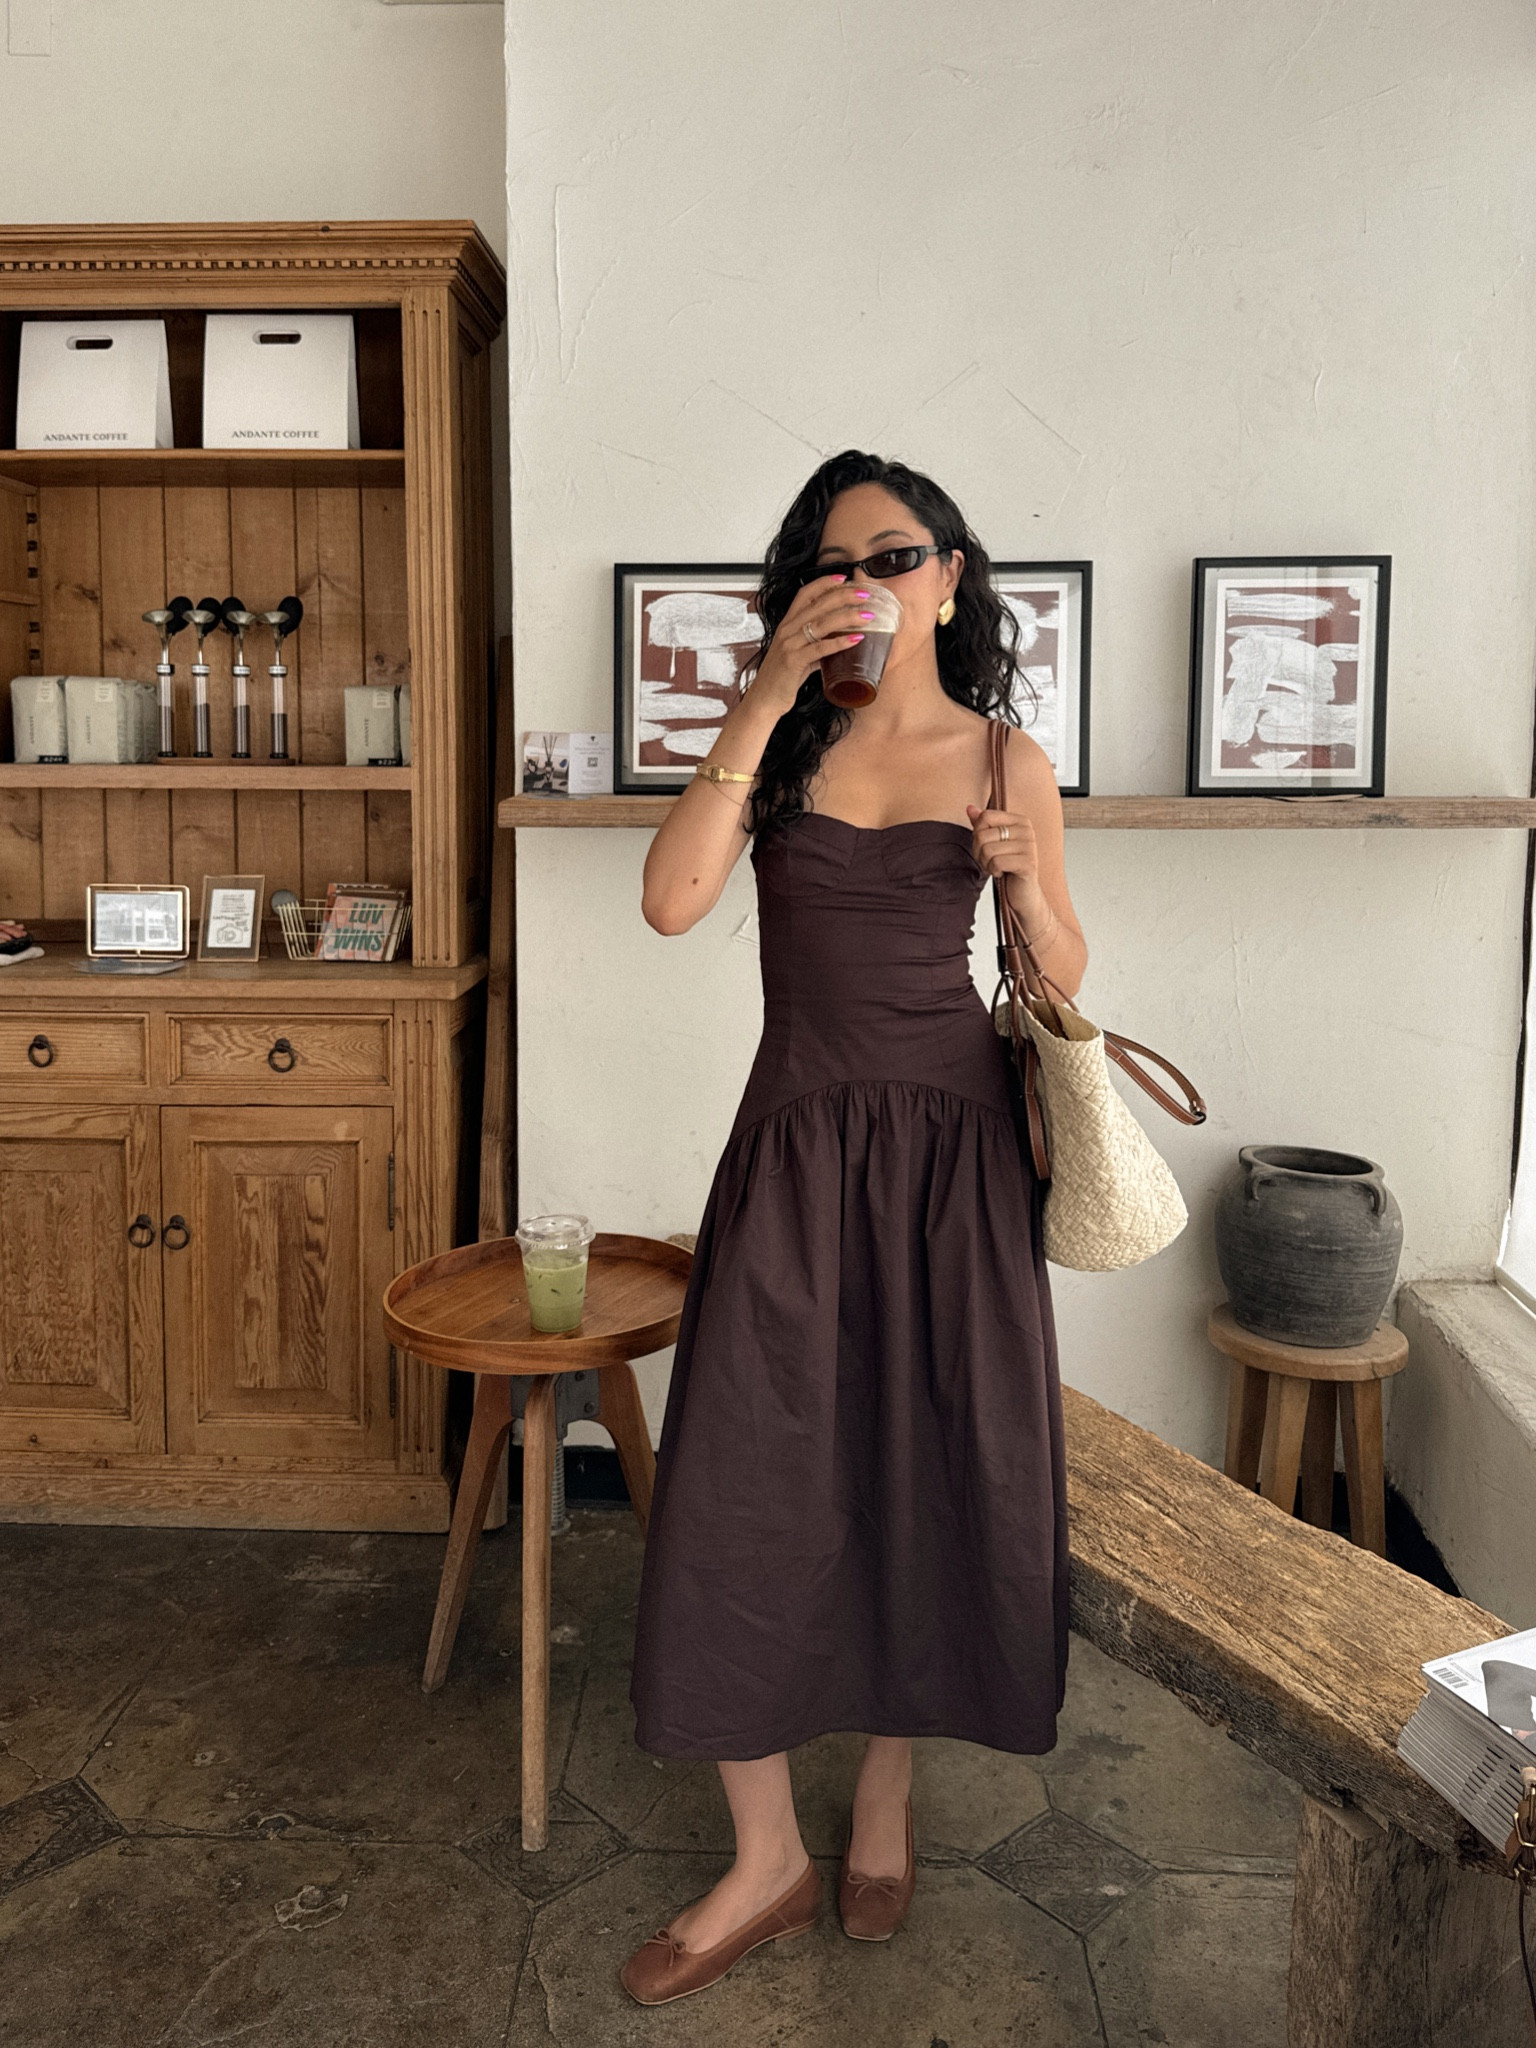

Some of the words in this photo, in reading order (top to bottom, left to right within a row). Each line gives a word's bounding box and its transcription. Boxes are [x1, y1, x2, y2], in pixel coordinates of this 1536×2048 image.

[43, 433, 90, 441] ANDANTE
[92, 432, 128, 441] COFFEE
[231, 430, 280, 439] ANDANTE
[282, 430, 319, 439] COFFEE
[348, 902, 386, 925] LUV
[333, 927, 385, 952] WINS
